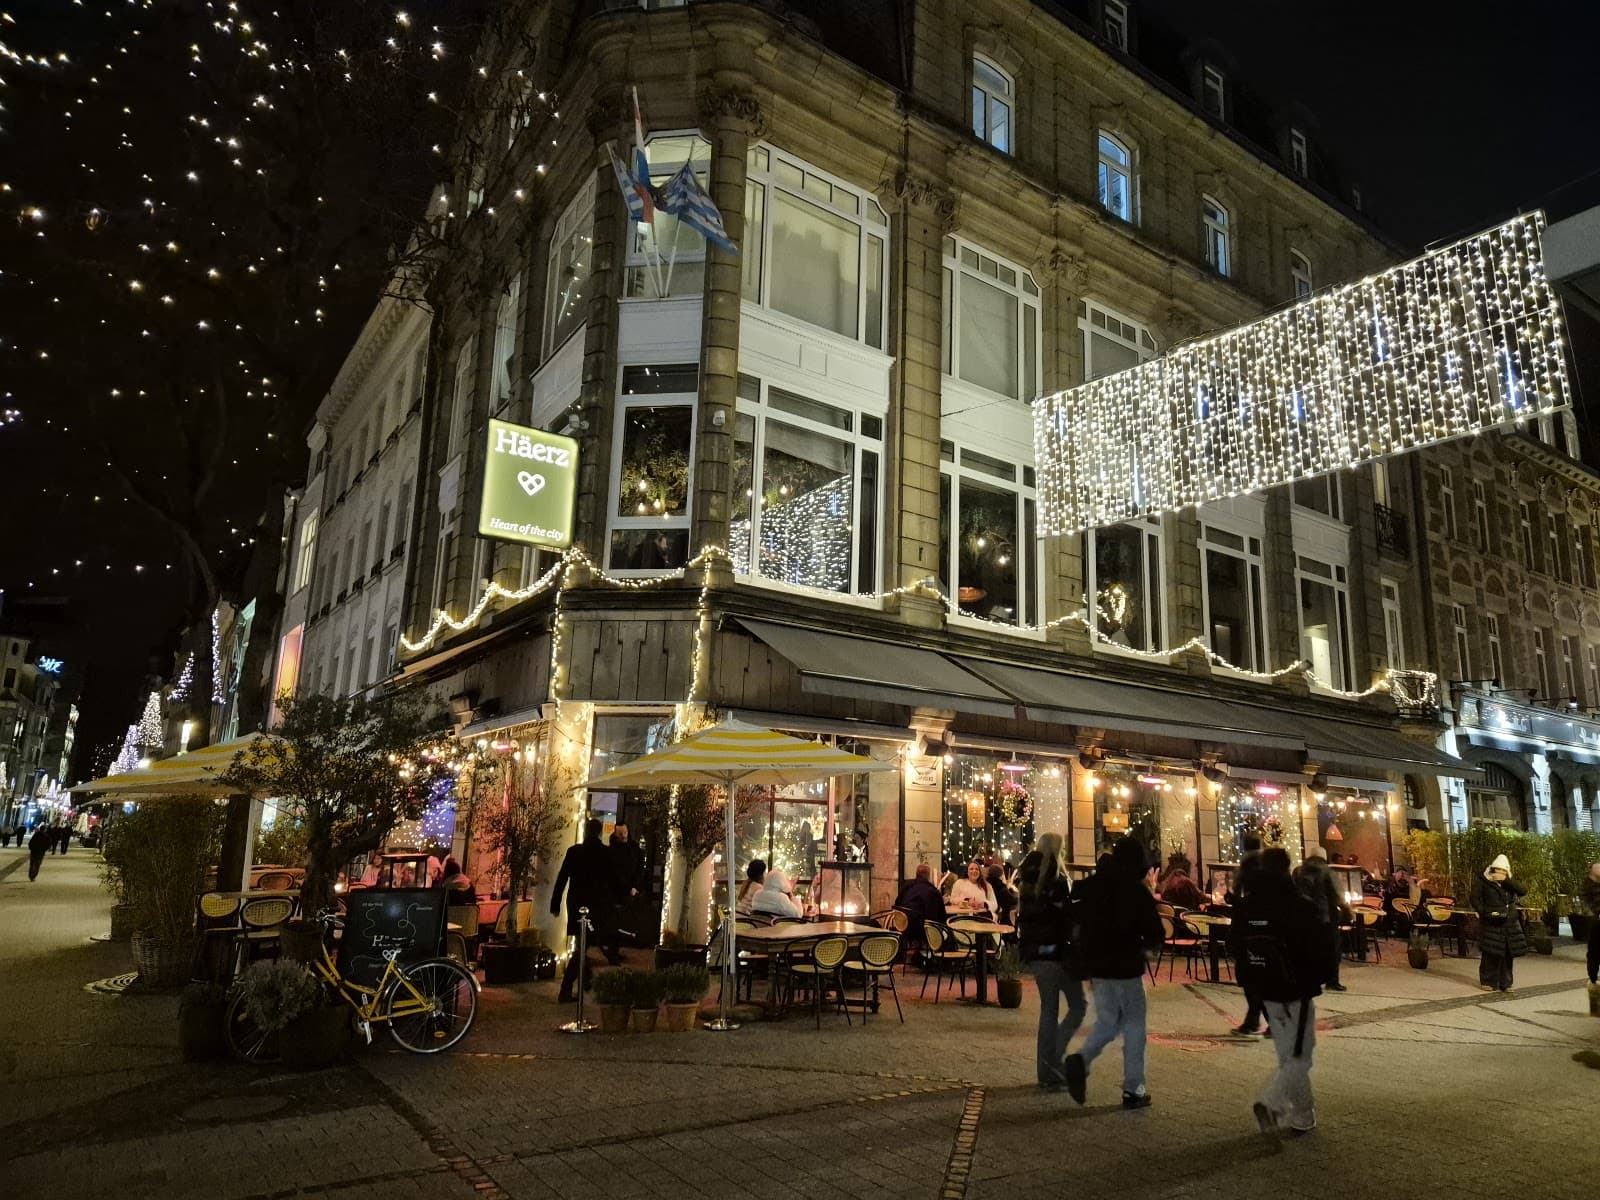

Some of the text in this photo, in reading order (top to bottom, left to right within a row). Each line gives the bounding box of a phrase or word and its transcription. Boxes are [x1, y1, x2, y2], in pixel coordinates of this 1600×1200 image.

[495, 428, 569, 467] Häerz
[490, 517, 564, 541] Heart of the city
